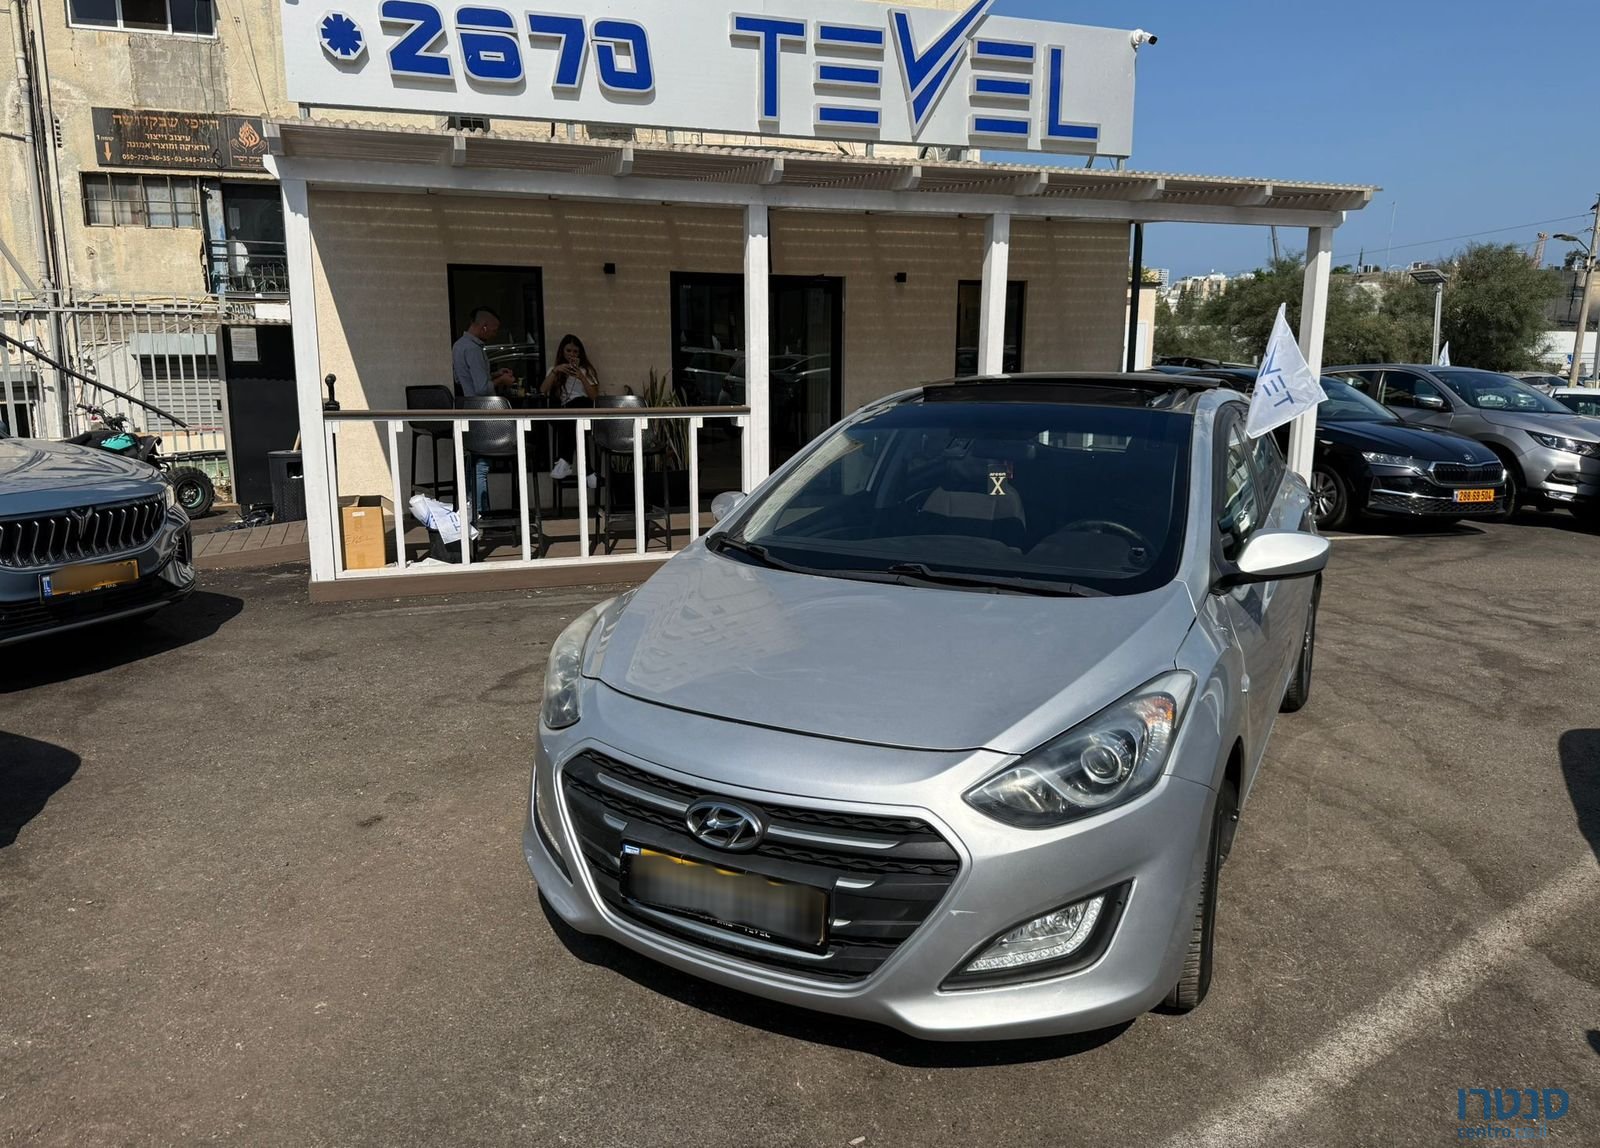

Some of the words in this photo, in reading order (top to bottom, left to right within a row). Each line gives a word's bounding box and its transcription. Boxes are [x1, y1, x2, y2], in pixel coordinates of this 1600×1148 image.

[729, 0, 1100, 142] TEVEL
[169, 133, 191, 142] עיצוב
[990, 477, 1005, 495] X
